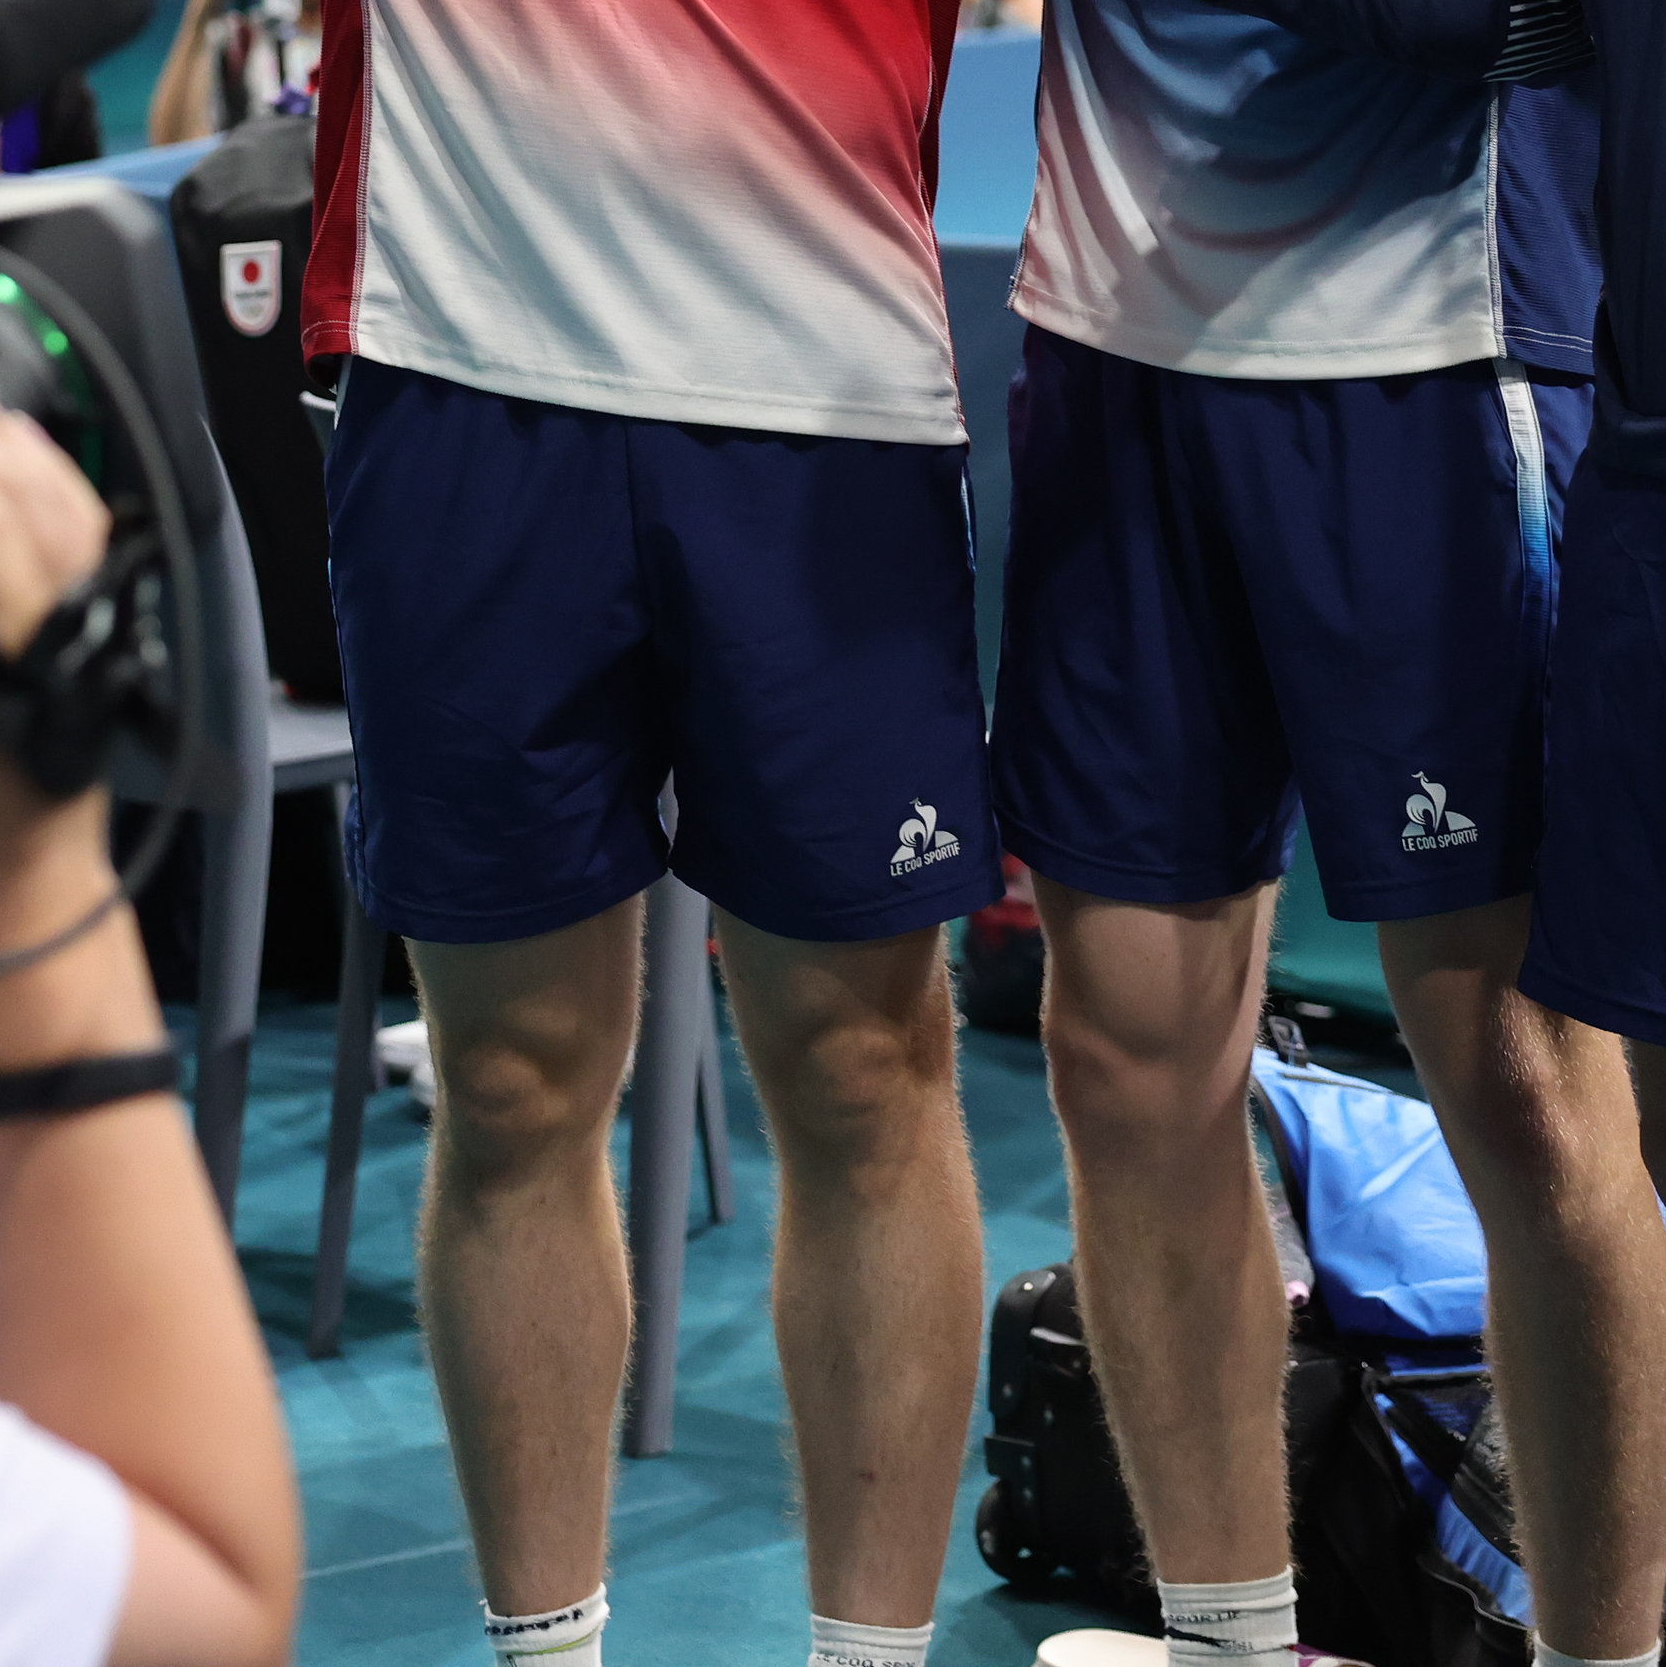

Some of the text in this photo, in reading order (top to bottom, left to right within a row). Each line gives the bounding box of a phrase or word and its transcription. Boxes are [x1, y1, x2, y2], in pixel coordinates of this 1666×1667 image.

[1401, 828, 1478, 851] LE COQ SPORTIF
[890, 842, 960, 876] LE COQ SPORTIF
